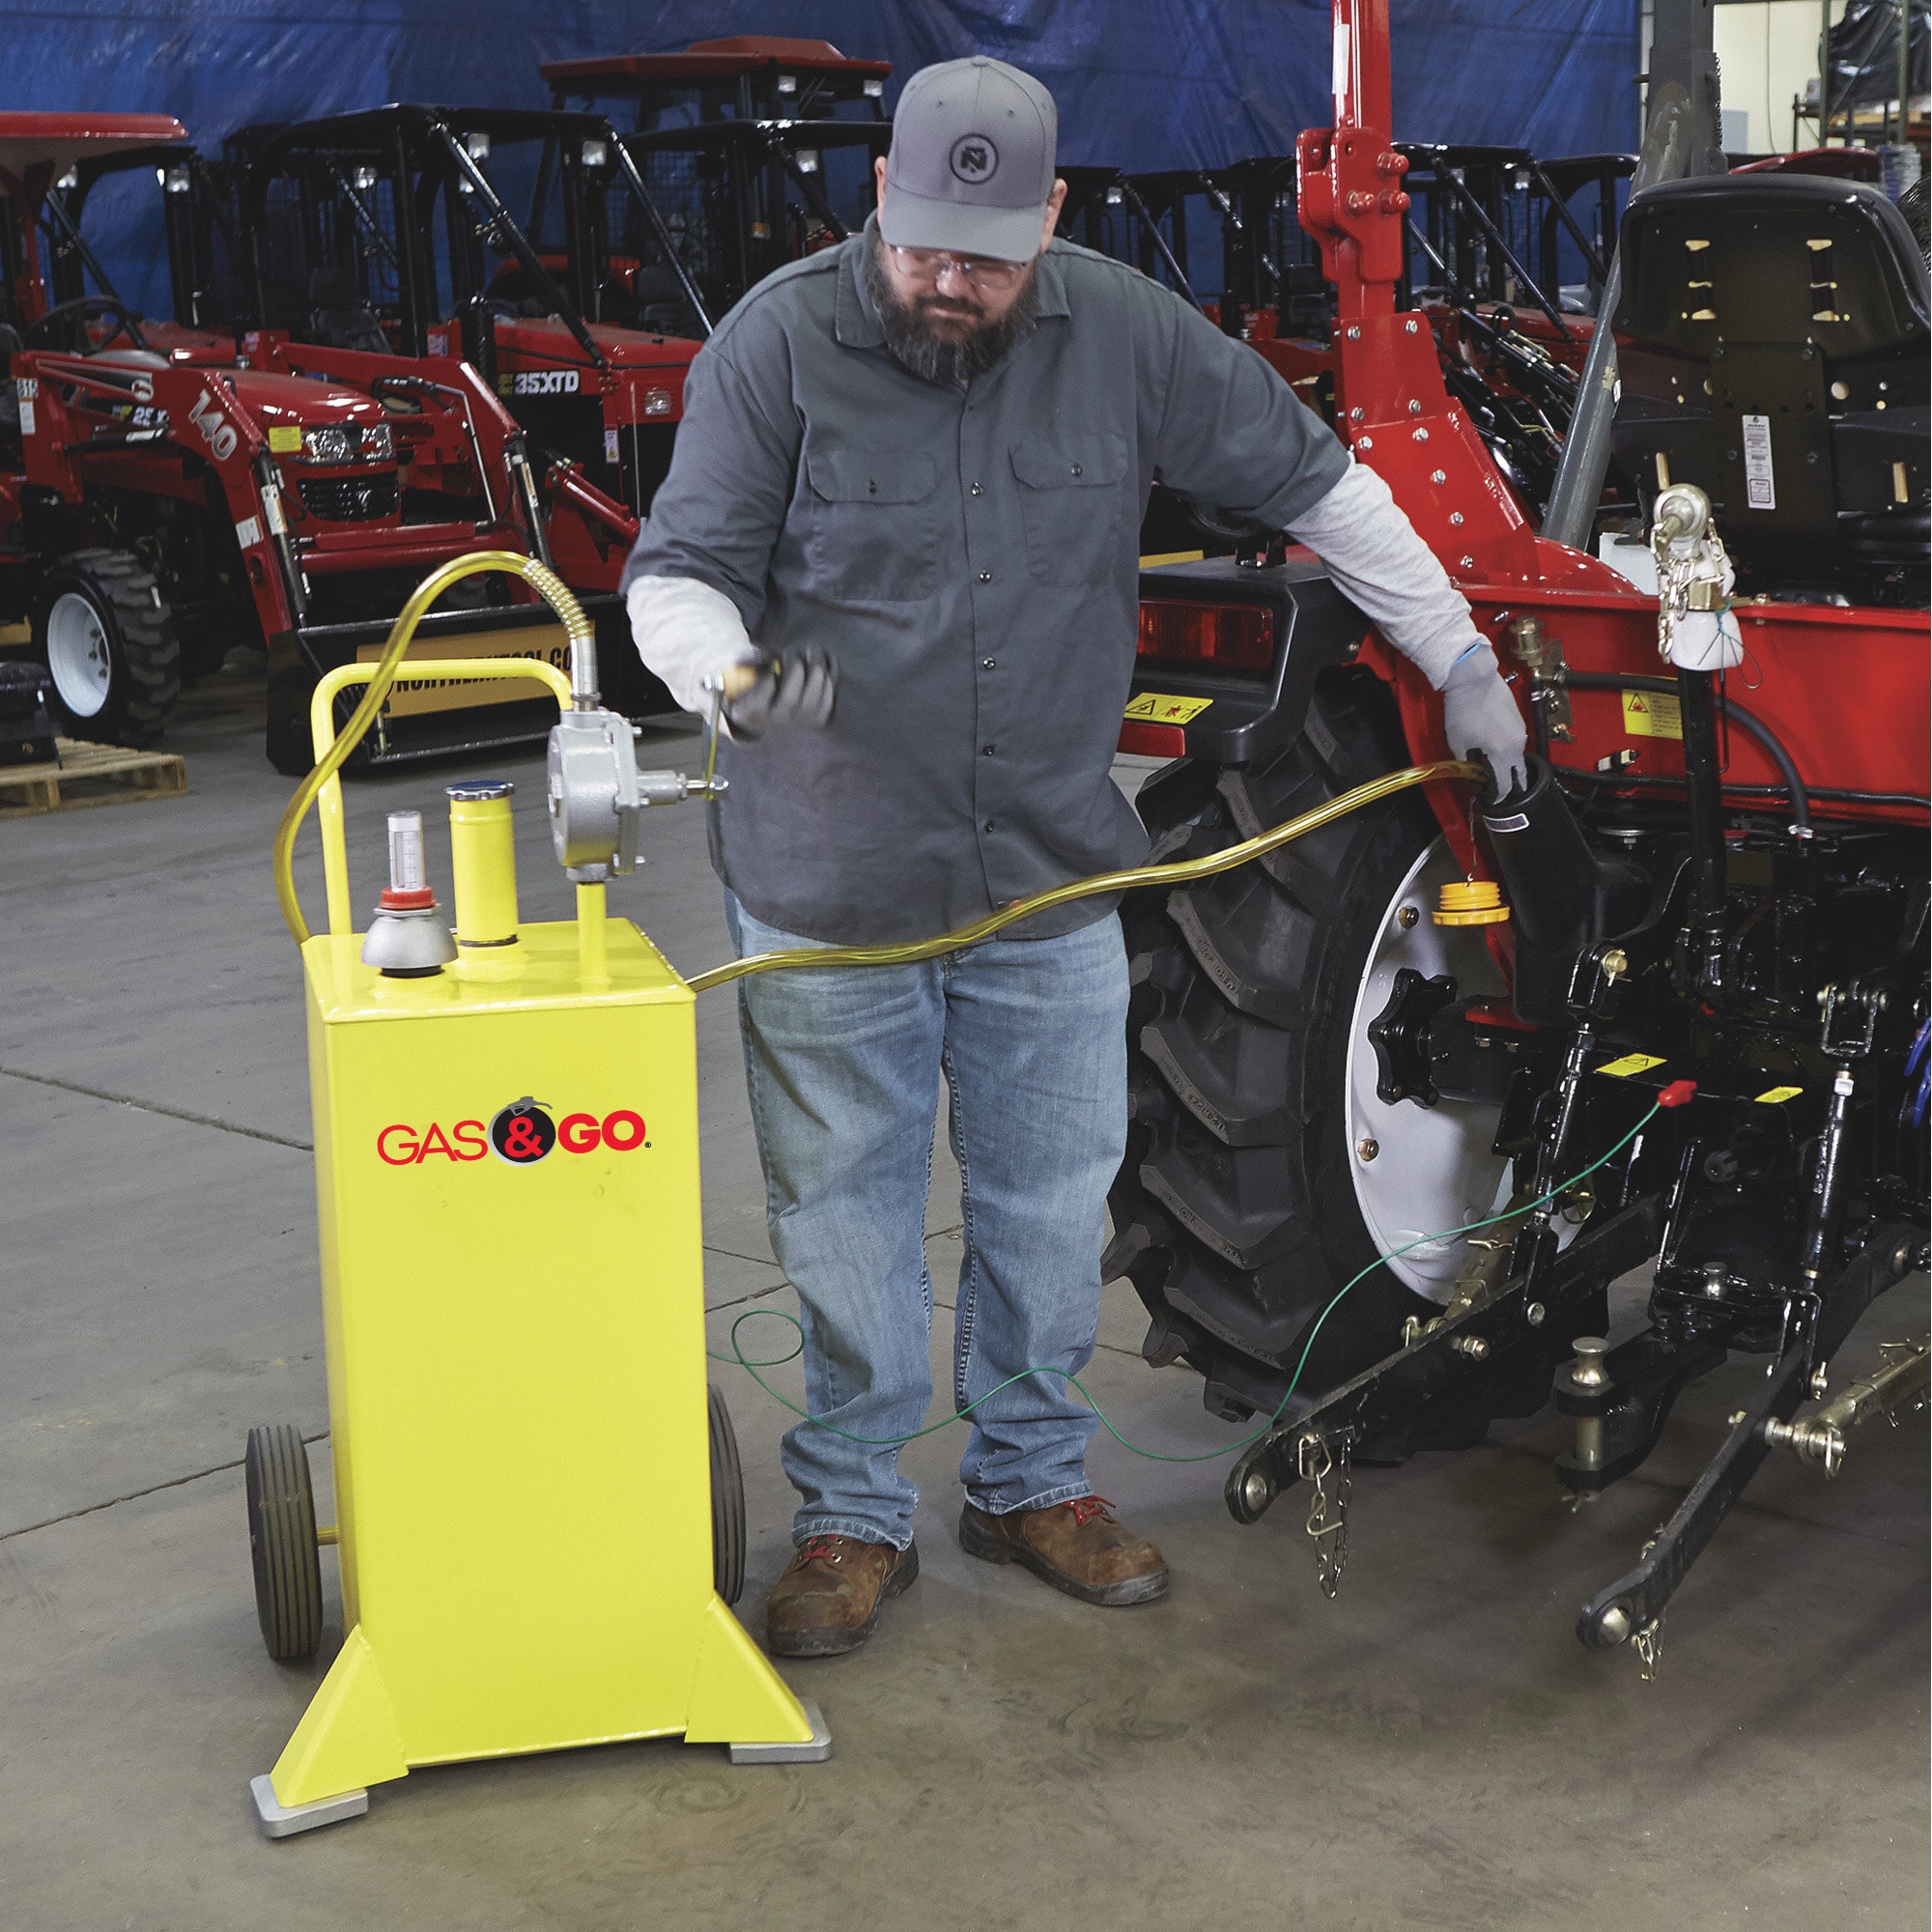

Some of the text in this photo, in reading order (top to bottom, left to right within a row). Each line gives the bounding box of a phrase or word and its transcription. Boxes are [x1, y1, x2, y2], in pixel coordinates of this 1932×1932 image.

[514, 370, 580, 395] 35XTD
[188, 388, 238, 462] 140
[377, 1110, 646, 1165] GAS & GO
